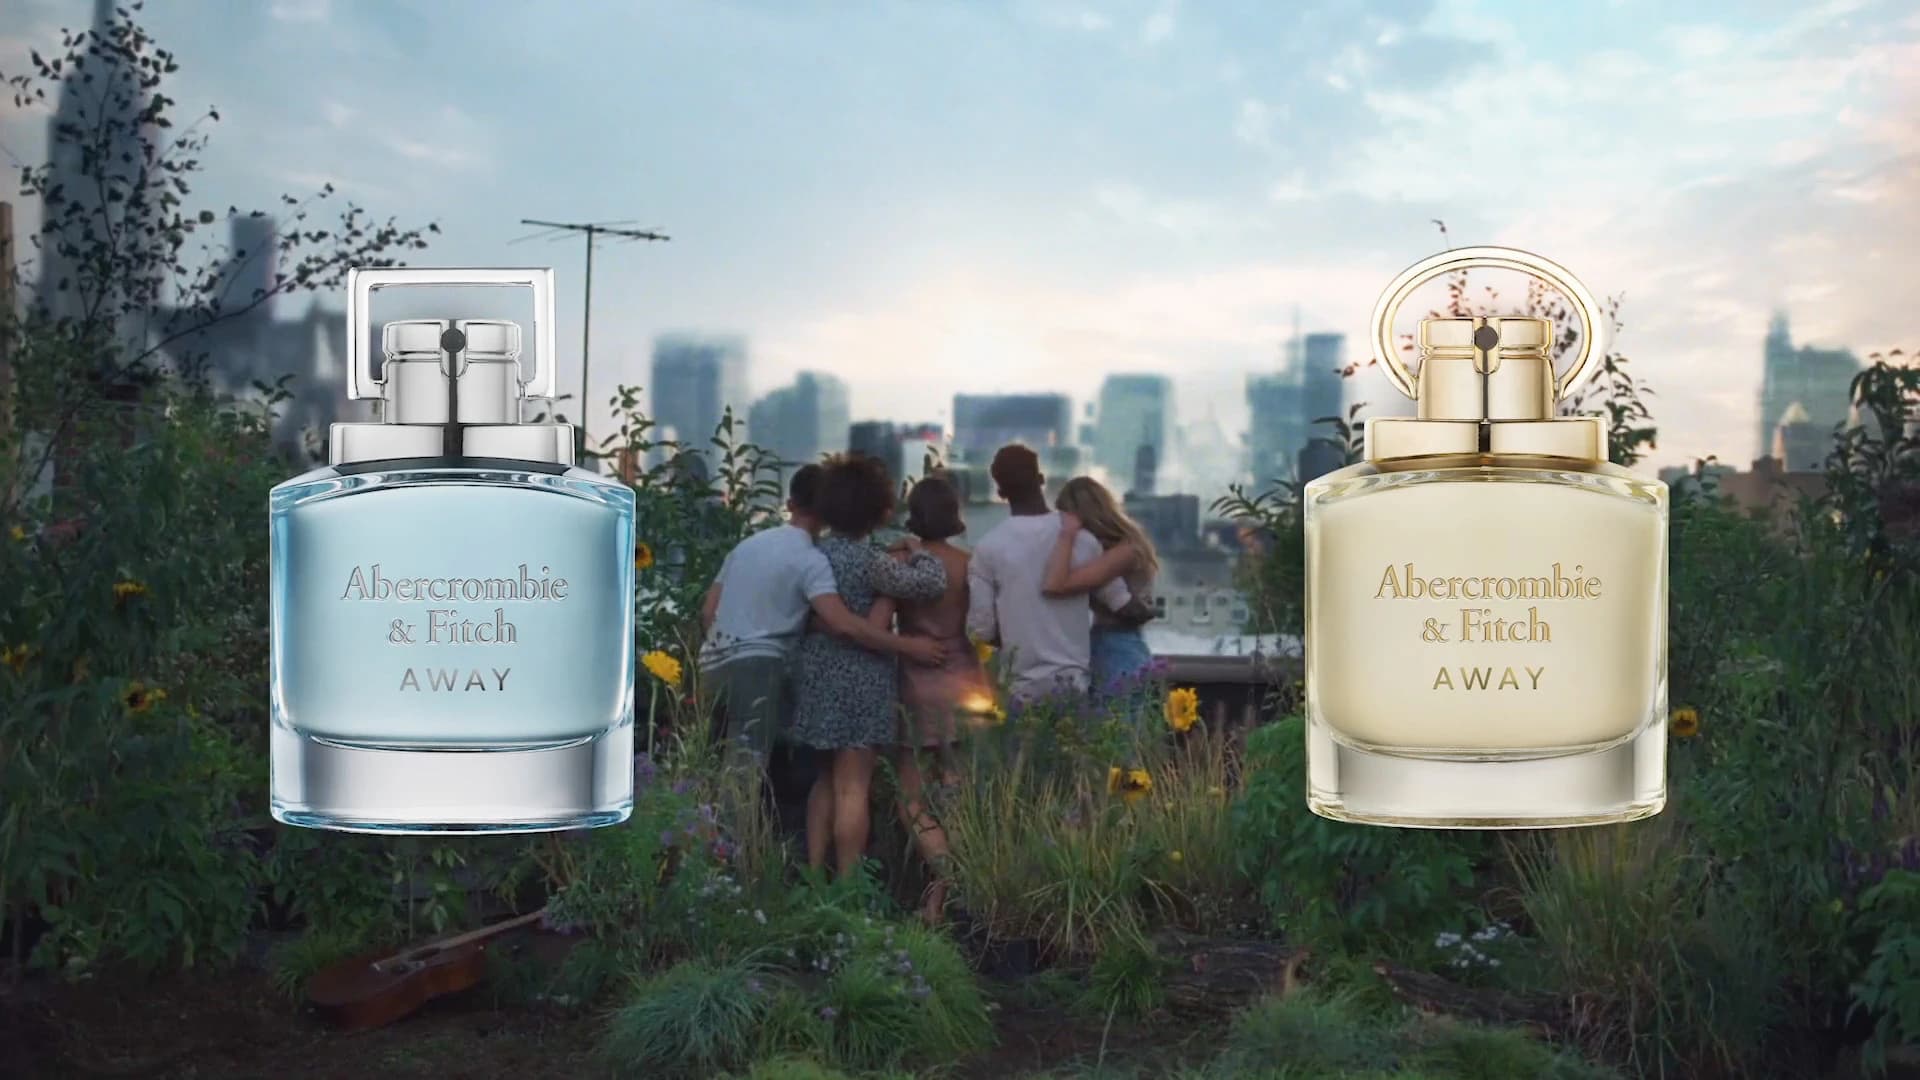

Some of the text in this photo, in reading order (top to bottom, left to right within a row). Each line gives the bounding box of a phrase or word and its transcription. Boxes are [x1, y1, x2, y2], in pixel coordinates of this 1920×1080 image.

[341, 563, 569, 601] Abercrombie
[1374, 562, 1602, 600] Abercrombie
[388, 607, 518, 644] & Fitch
[1421, 606, 1552, 643] & Fitch
[400, 667, 511, 692] AWAY
[1432, 666, 1545, 691] AWAY
